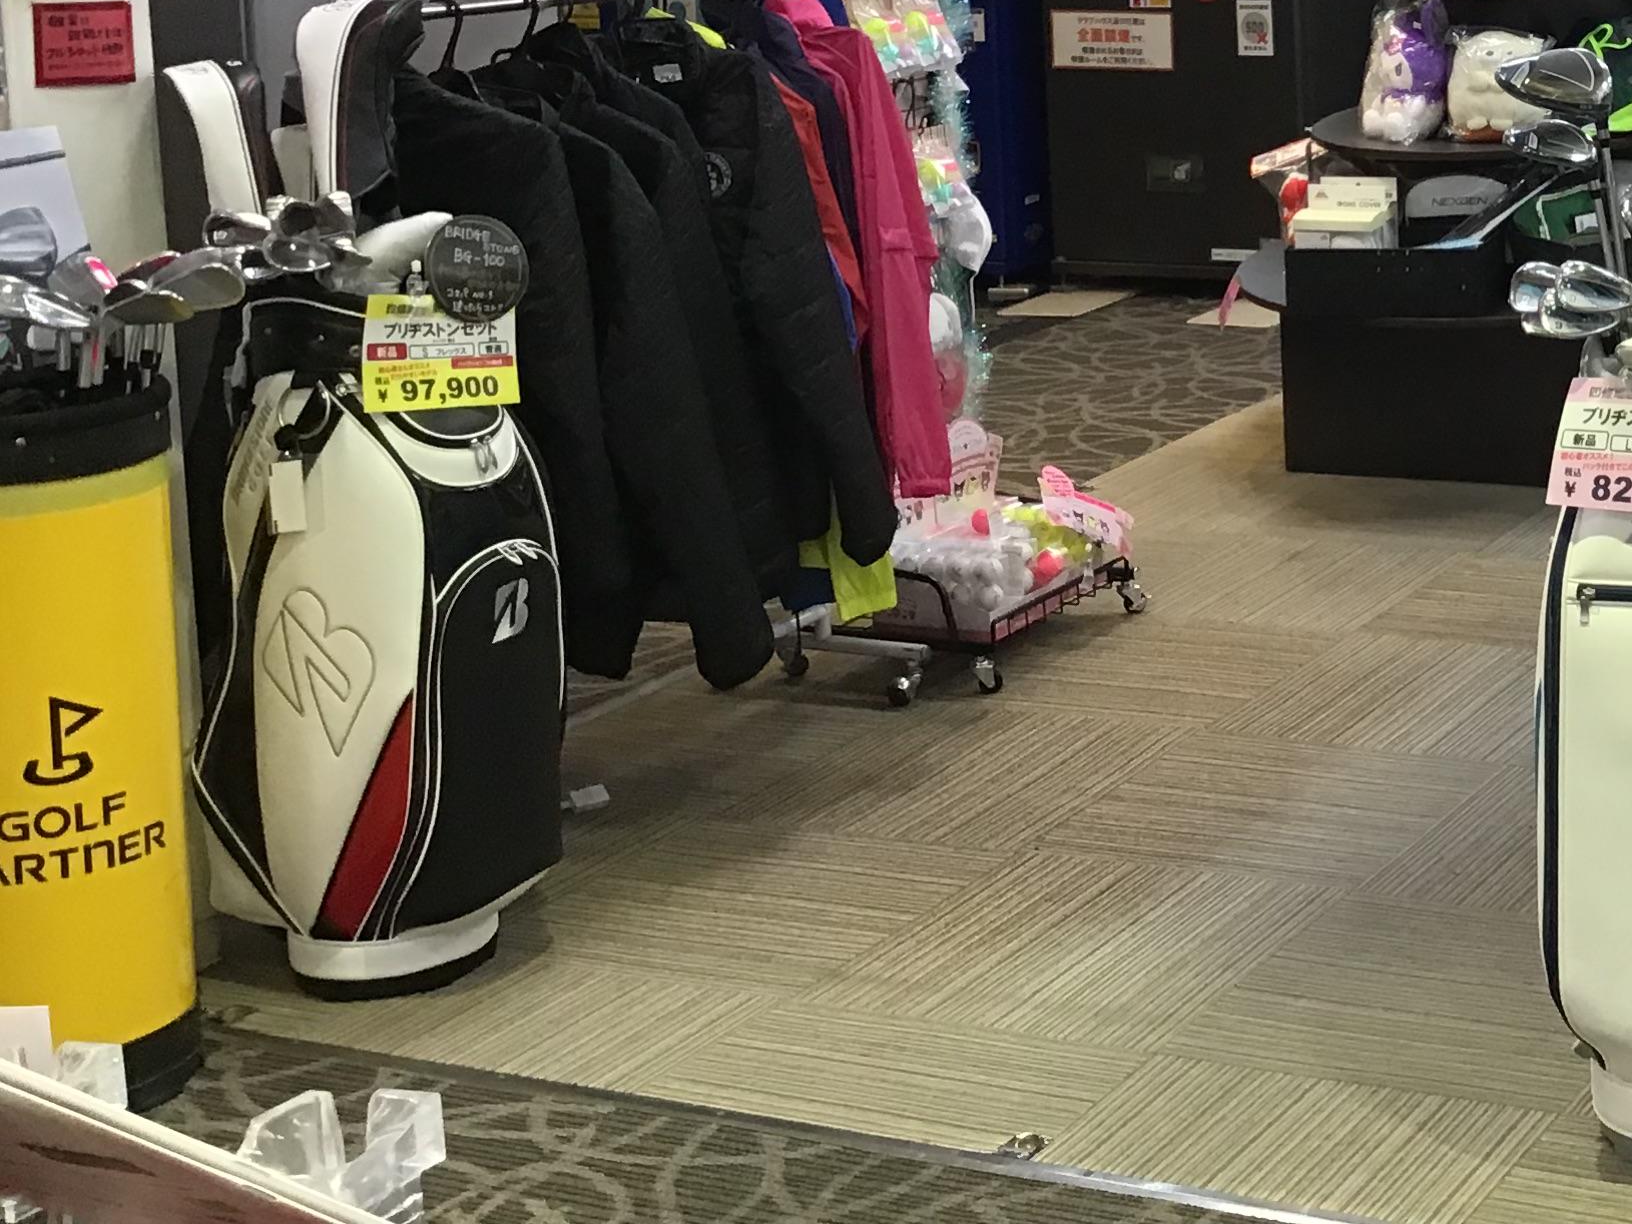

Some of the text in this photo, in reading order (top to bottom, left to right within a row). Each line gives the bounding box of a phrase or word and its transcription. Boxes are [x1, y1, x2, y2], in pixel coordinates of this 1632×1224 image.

[400, 375, 499, 405] 97,900
[1572, 432, 1597, 447] 新品
[1625, 438, 1632, 452] L
[1564, 467, 1582, 477] 税込
[1563, 481, 1577, 498] ¥
[0, 792, 127, 839] GOLF
[0, 820, 167, 886] RTNER
